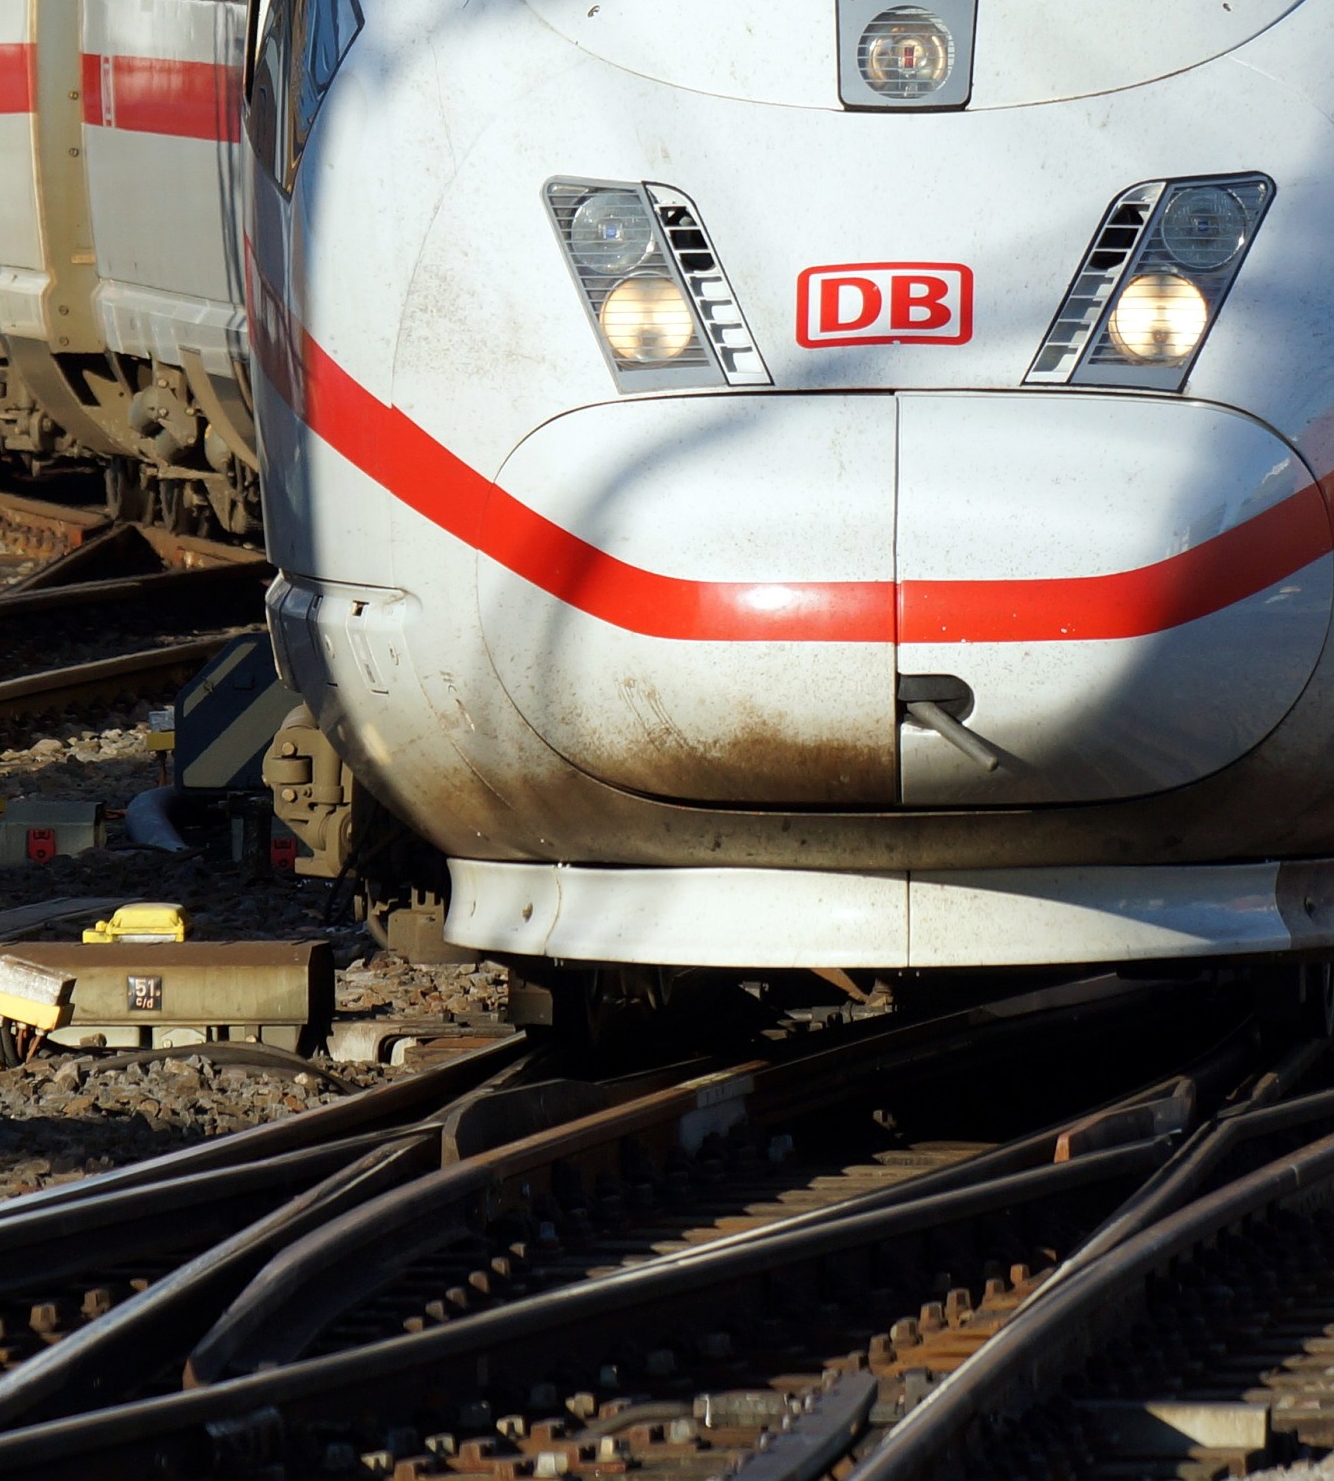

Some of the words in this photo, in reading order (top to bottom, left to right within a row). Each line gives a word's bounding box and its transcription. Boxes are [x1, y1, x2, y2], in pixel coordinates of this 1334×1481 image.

[820, 276, 952, 333] DB
[135, 978, 155, 997] 51
[136, 997, 154, 1009] c/d
